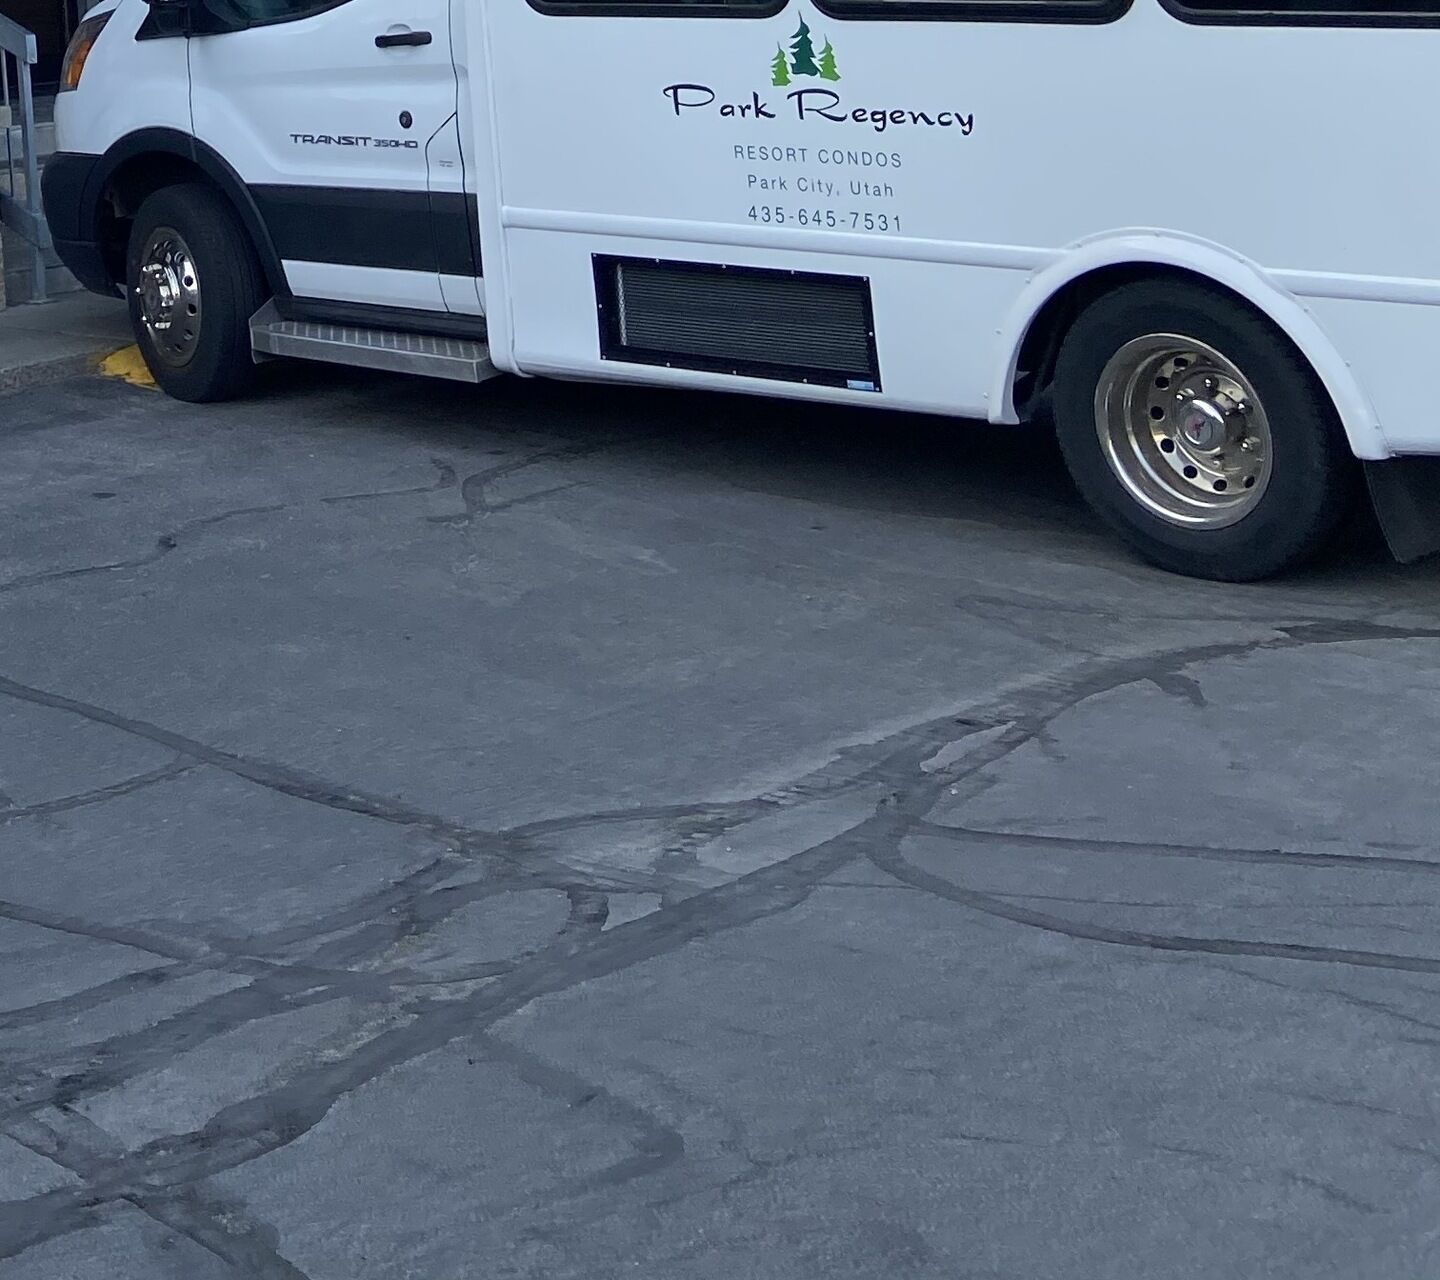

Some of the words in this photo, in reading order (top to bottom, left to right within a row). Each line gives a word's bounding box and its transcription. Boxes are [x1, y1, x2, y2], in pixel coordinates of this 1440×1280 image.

[663, 83, 776, 119] Park
[787, 88, 974, 135] Regency
[290, 134, 372, 147] TRANSIT
[734, 145, 808, 163] RESORT
[818, 149, 902, 168] CONDOS
[747, 175, 788, 191] Park
[797, 177, 840, 197] City,
[850, 180, 894, 197] Utah
[748, 205, 902, 232] 435-645-7531
